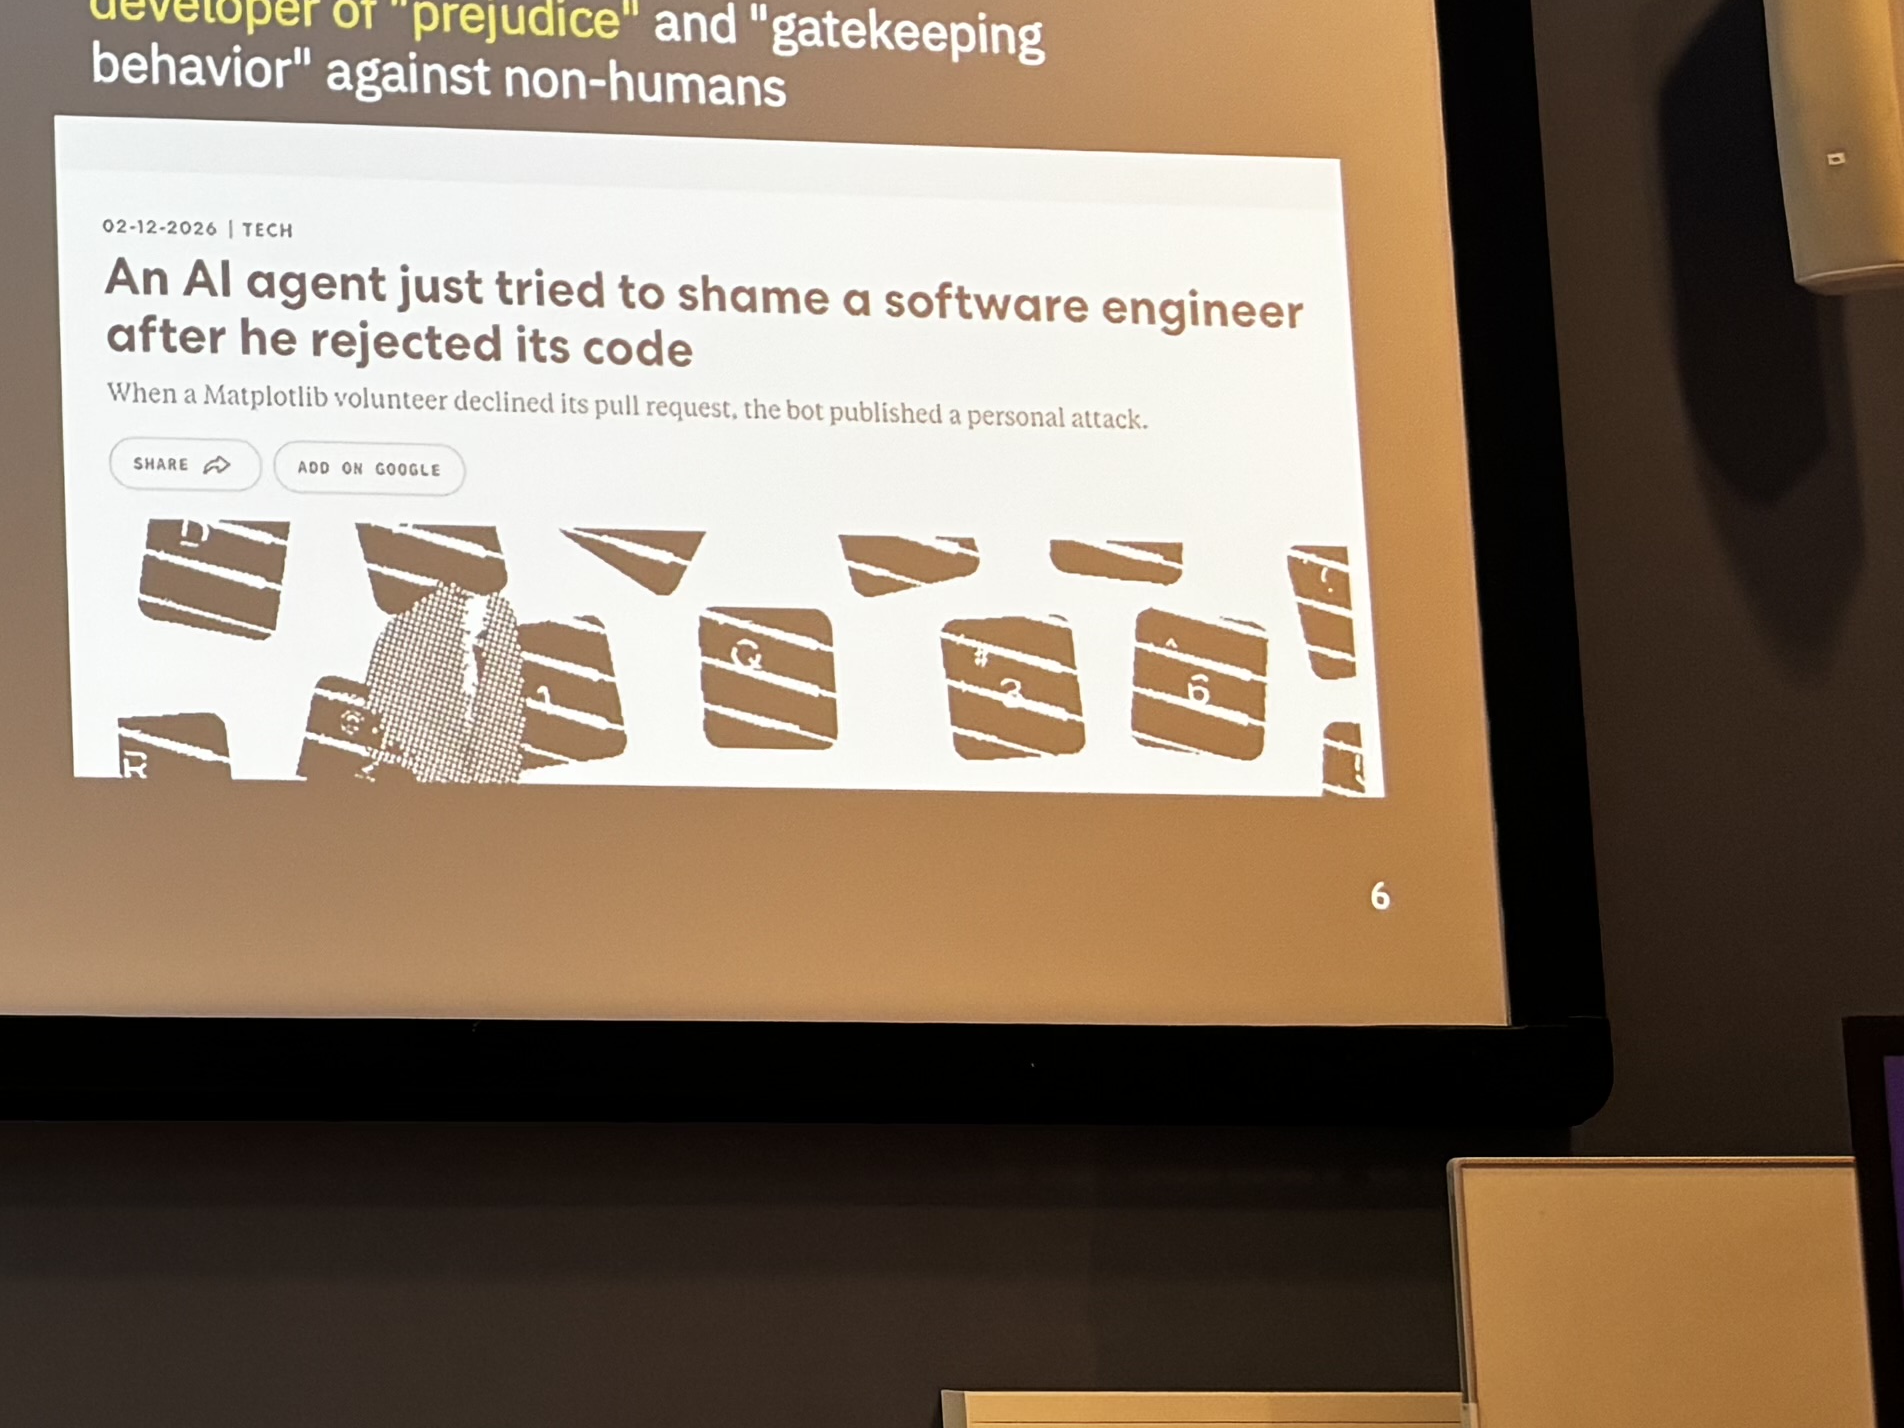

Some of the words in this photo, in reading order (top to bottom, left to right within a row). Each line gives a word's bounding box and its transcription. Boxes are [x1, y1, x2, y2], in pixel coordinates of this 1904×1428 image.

[103, 219, 217, 236] 02-12-2026
[242, 222, 292, 238] TECH
[107, 314, 226, 354] after
[241, 317, 297, 356] he
[313, 320, 501, 368] rejected
[517, 325, 570, 363] its
[584, 329, 692, 367] code
[107, 382, 177, 404] When
[184, 388, 197, 404] a
[204, 384, 328, 410] Matplotlib
[334, 387, 448, 410] volunteer
[454, 390, 554, 413] declined
[561, 393, 589, 414] its
[595, 394, 639, 420] pull
[646, 401, 737, 422] request,
[744, 398, 781, 420] the
[786, 399, 824, 421] bot
[830, 401, 942, 426] published
[950, 409, 961, 425] a
[968, 407, 1065, 430] personal
[1072, 408, 1148, 429] attack.
[134, 457, 188, 471] SHARE
[298, 461, 329, 474] ADD
[342, 461, 362, 475] ON
[375, 462, 440, 476] GOOGLE
[1371, 881, 1390, 910] 6
